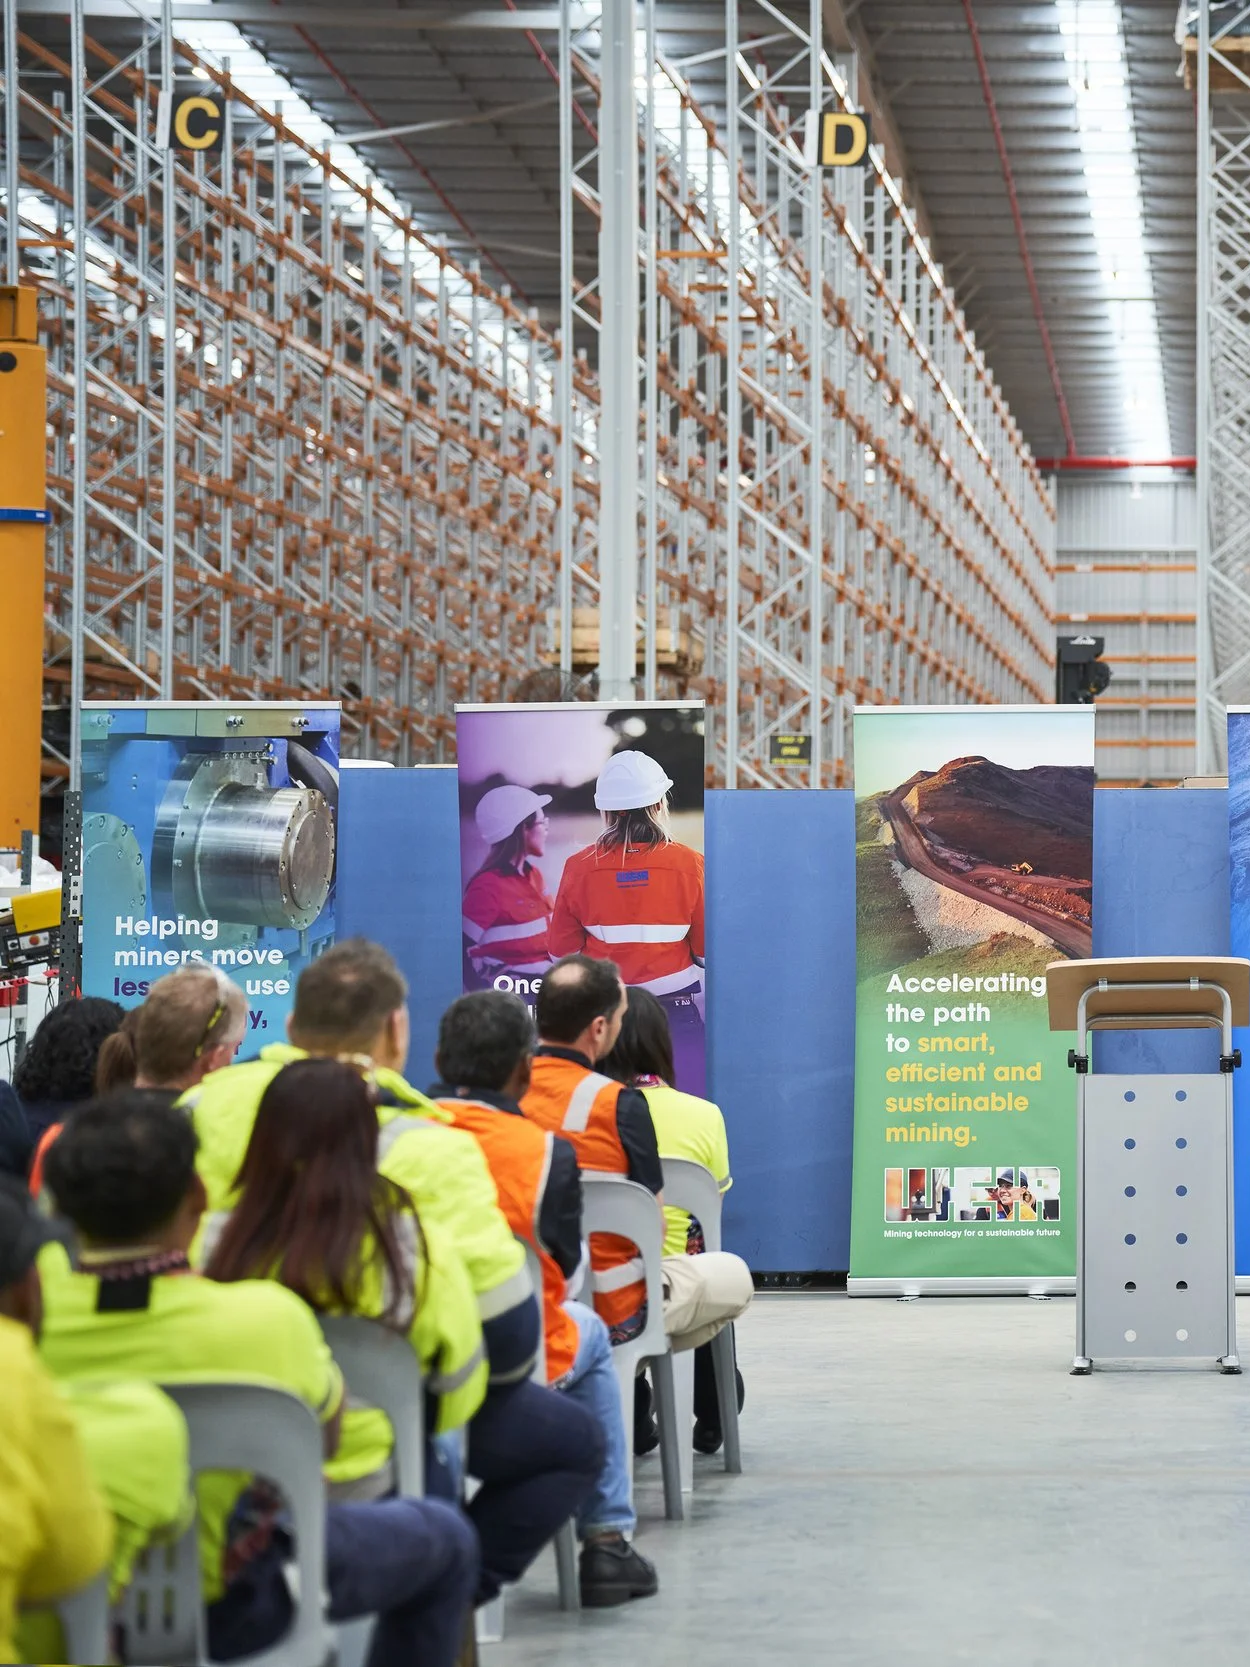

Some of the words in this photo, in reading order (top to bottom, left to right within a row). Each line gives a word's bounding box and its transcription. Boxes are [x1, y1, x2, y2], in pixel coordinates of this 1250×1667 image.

[175, 96, 220, 149] C
[822, 113, 867, 166] D
[115, 915, 219, 940] Helping
[114, 946, 204, 966] miners
[212, 949, 284, 965] move
[114, 977, 151, 996] les
[246, 979, 291, 995] use
[886, 973, 1047, 997] Accelerating
[886, 1003, 926, 1023] the
[934, 1002, 991, 1026] path
[886, 1033, 910, 1052] to
[918, 1032, 995, 1055] smart,
[886, 1062, 986, 1082] efficient
[994, 1061, 1042, 1081] and
[886, 1092, 1029, 1112] sustainable
[886, 1122, 977, 1147] mining.
[884, 1166, 1061, 1223] WEIR
[884, 1230, 913, 1239] Mining
[915, 1229, 962, 1239] technology
[964, 1228, 976, 1237] for
[985, 1228, 1035, 1237] sustainable
[1036, 1228, 1061, 1236] future
